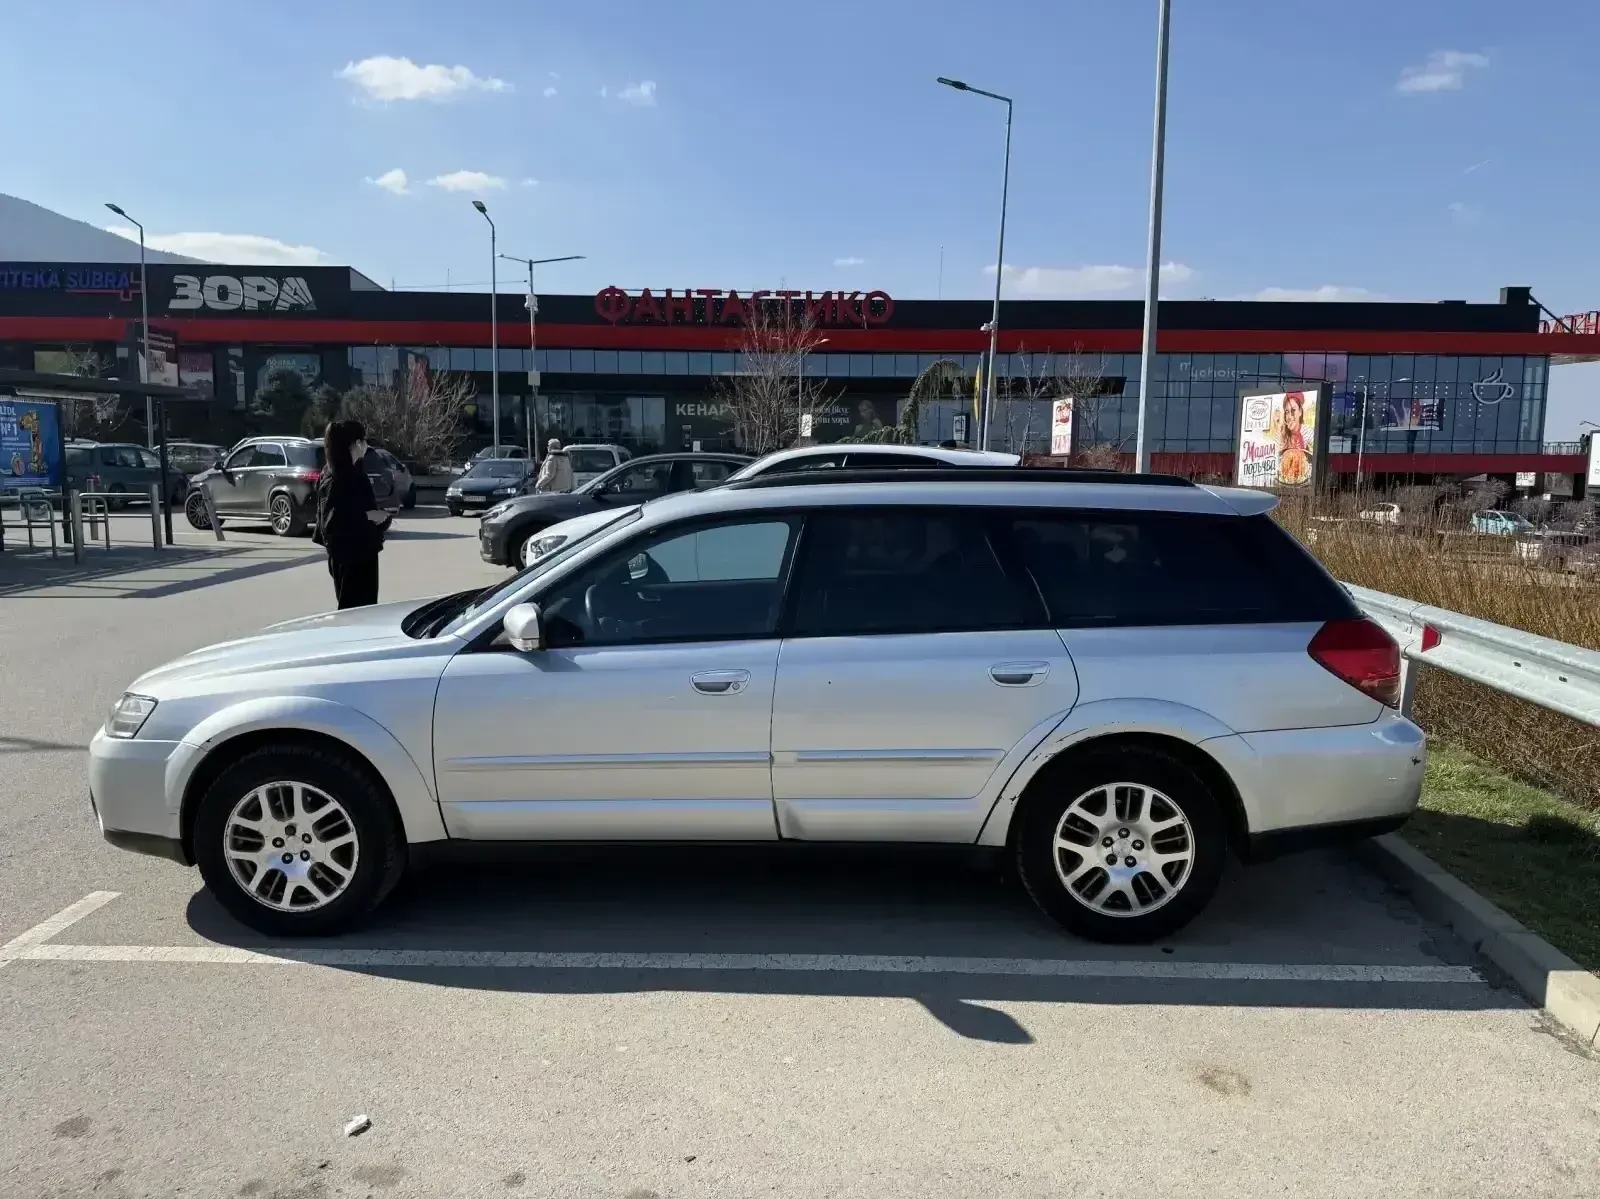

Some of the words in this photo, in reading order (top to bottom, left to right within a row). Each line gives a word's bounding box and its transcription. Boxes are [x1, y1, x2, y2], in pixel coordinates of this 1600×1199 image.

[67, 271, 130, 289] SUBRA
[168, 274, 317, 311] ЗОРА
[594, 285, 895, 324] ФАНТАСТИКО
[1242, 441, 1276, 463] Мадам
[1243, 460, 1276, 477] поръчва
